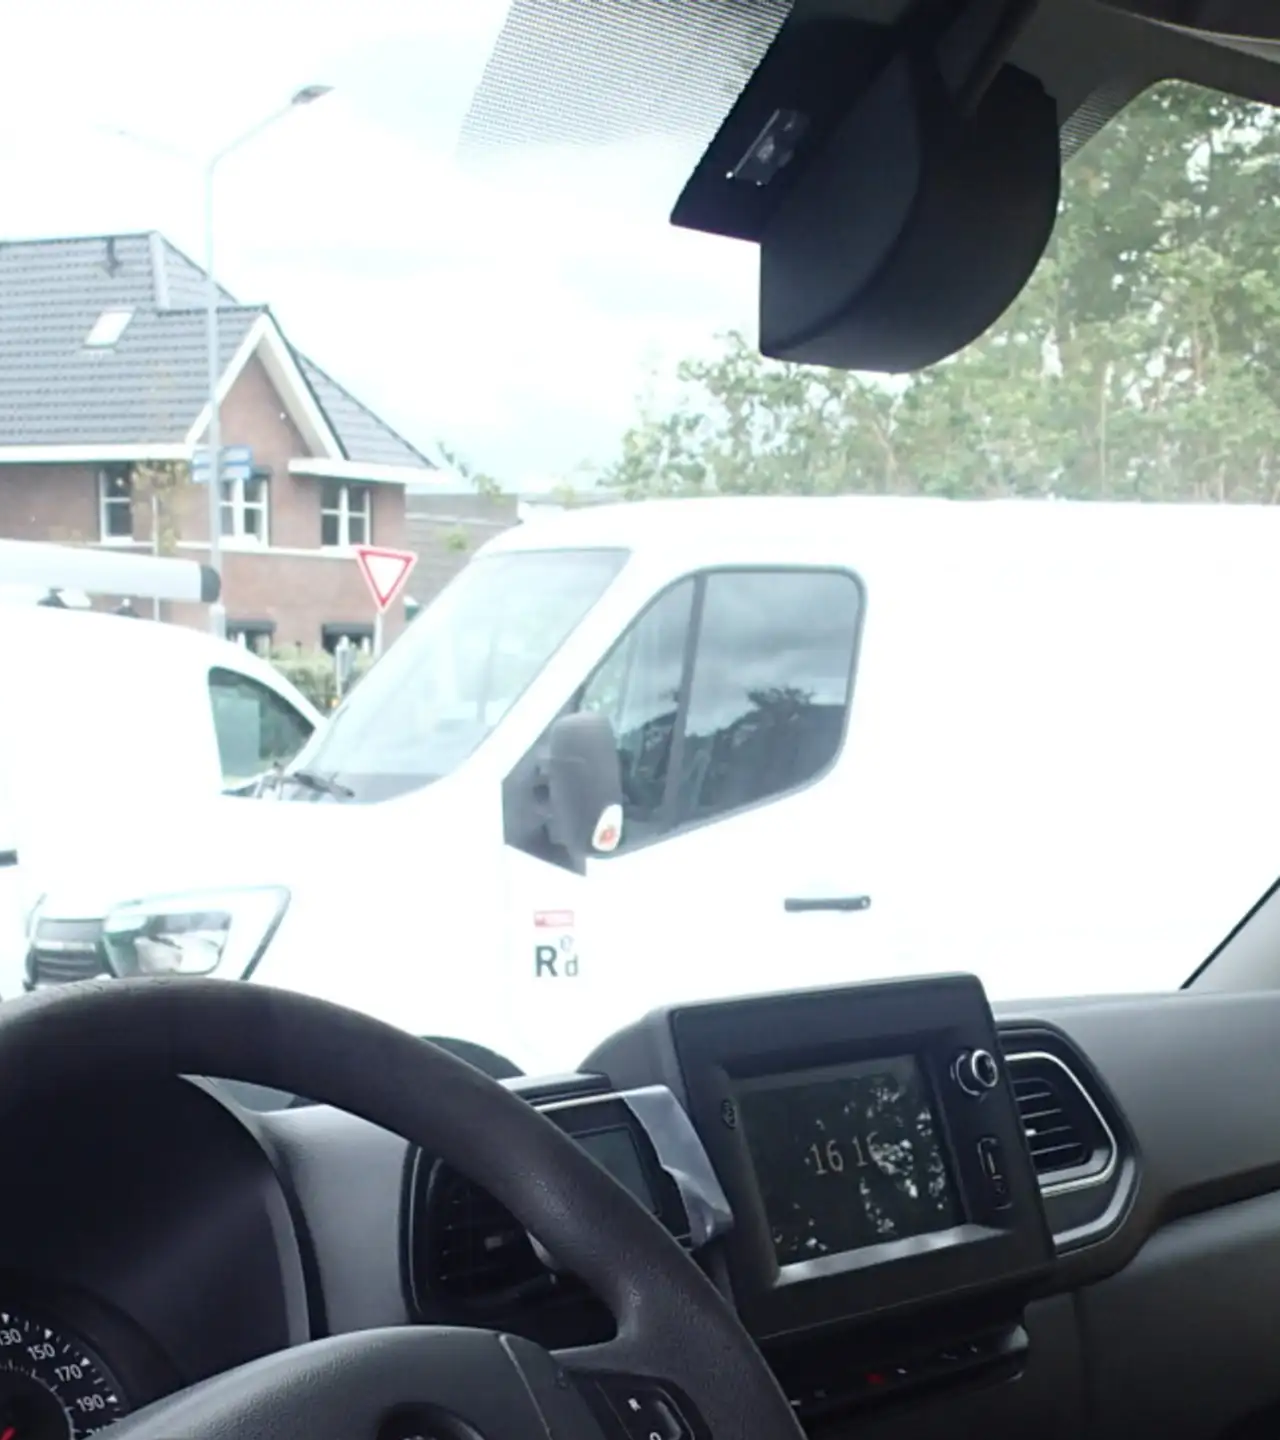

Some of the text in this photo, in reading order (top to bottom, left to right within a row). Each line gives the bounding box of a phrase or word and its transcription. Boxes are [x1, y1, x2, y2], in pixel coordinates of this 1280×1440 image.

[27, 1343, 57, 1361] 150
[54, 1363, 83, 1382] 170
[76, 1394, 105, 1412] 190
